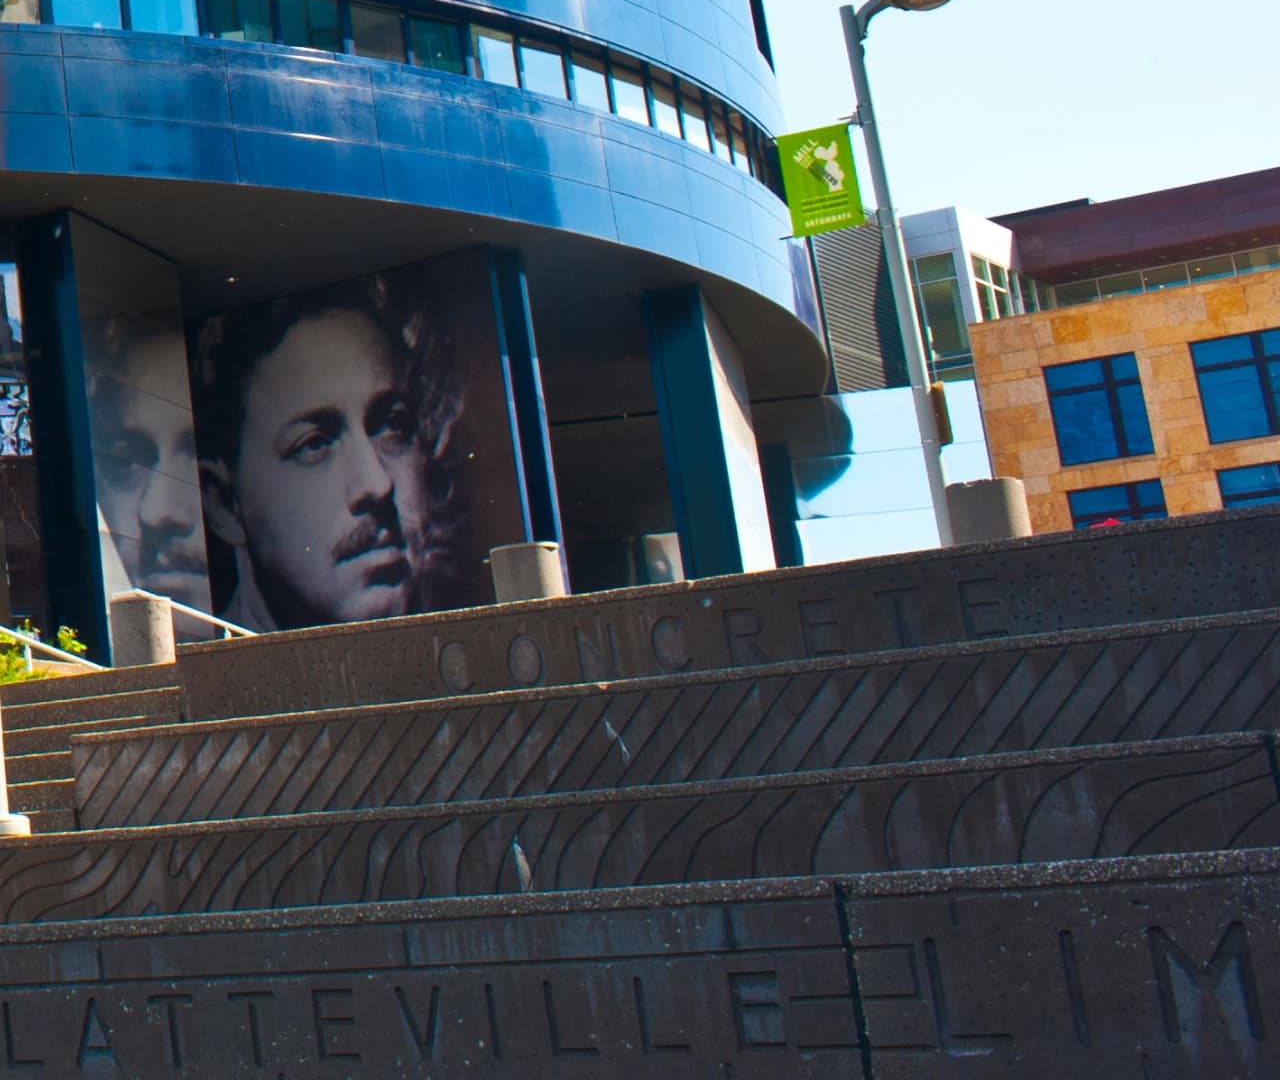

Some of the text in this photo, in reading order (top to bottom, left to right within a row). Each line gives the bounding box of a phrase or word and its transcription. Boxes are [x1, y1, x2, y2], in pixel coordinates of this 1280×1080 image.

[793, 139, 817, 162] MILL
[439, 575, 1010, 694] CONCRETE
[922, 919, 1267, 1048] LIM
